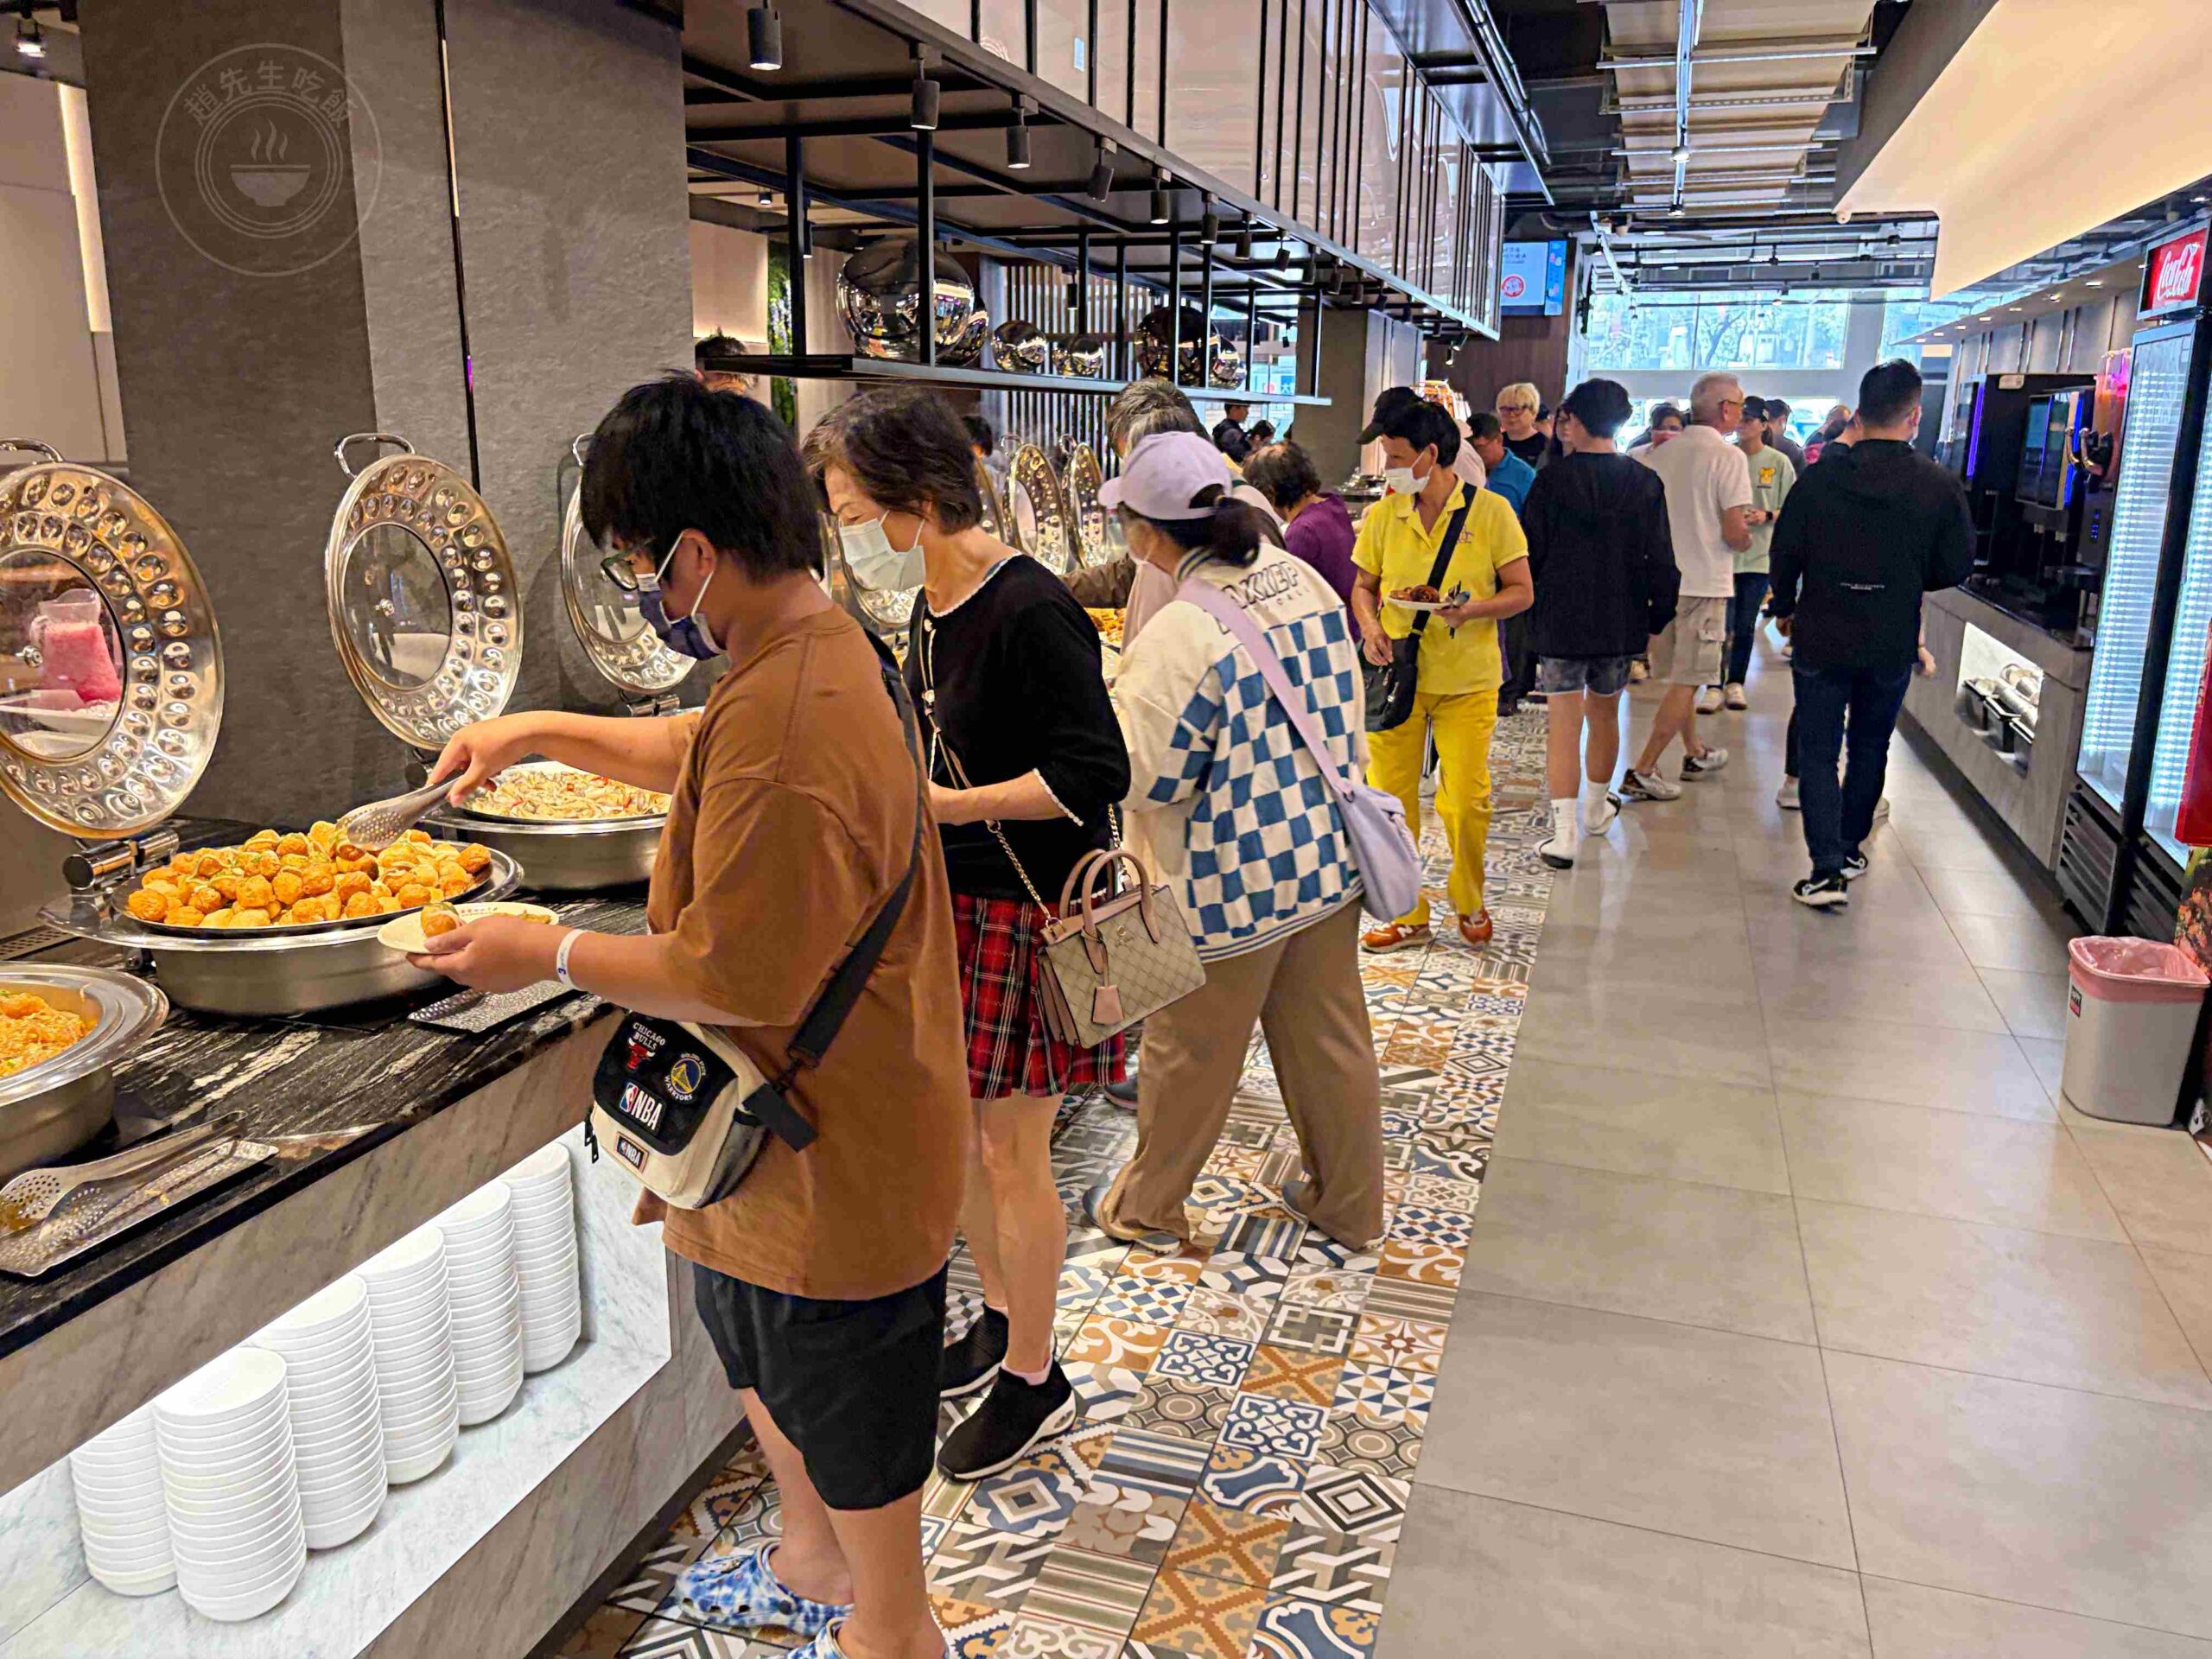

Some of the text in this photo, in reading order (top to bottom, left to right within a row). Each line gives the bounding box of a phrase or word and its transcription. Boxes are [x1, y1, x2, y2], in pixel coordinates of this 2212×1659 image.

[632, 1022, 666, 1046] CHICAGO
[632, 1032, 658, 1051] BULLS
[664, 1074, 693, 1101] WARRIORS
[631, 1090, 663, 1131] NBA
[625, 1143, 642, 1166] NBA
